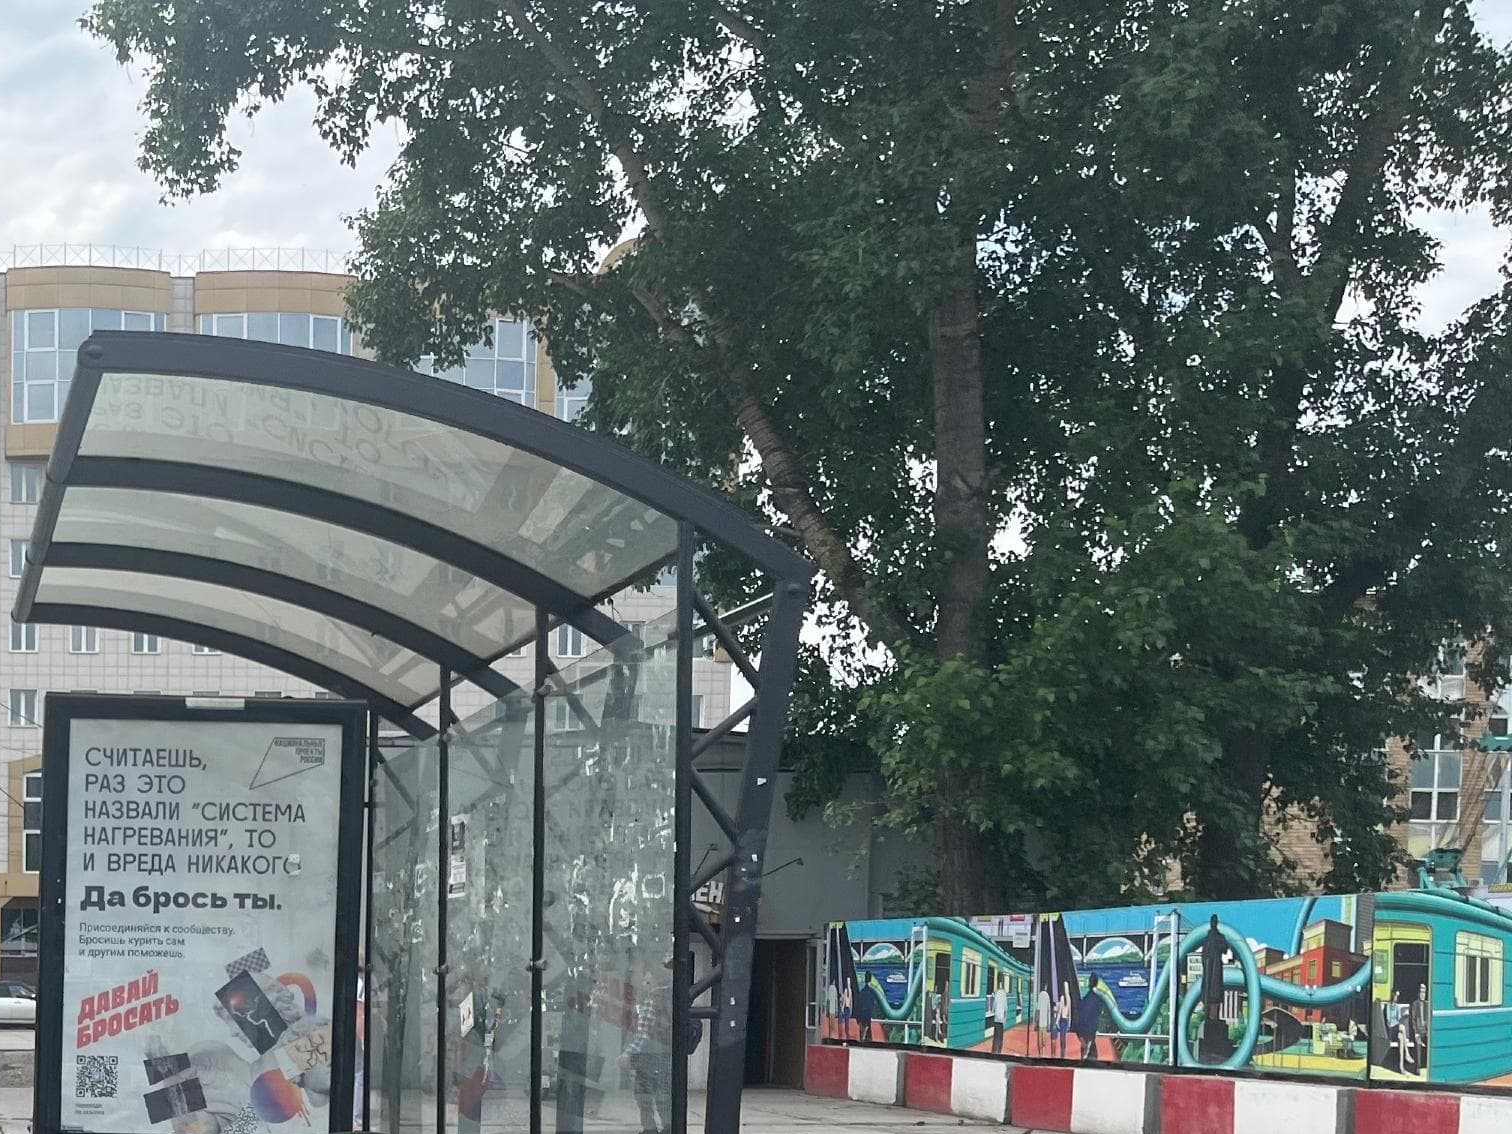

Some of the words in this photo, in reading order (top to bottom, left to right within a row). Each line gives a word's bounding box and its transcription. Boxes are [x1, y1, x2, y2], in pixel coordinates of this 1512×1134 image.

[85, 747, 207, 770] СЧИТАЕШЬ,
[85, 774, 126, 793] РАЗ
[138, 775, 186, 794] ЭТО
[84, 800, 180, 820] НАЗВАЛИ
[245, 830, 276, 848] ТО
[83, 852, 95, 872] И
[108, 854, 176, 876] ВРЕДА
[80, 886, 126, 911] Да
[132, 886, 228, 914] брось
[234, 893, 282, 910] ты.
[79, 922, 161, 933] Присоединяйся
[164, 925, 170, 933] к
[172, 924, 236, 936] сообществу.
[79, 935, 125, 946] Бросишь
[128, 938, 163, 947] курить
[166, 938, 185, 946] сам
[88, 950, 124, 958] другим
[128, 950, 185, 958] поможешь.
[78, 969, 158, 1024] ДАВАЙ
[77, 994, 179, 1048] БРОСАТЬ
